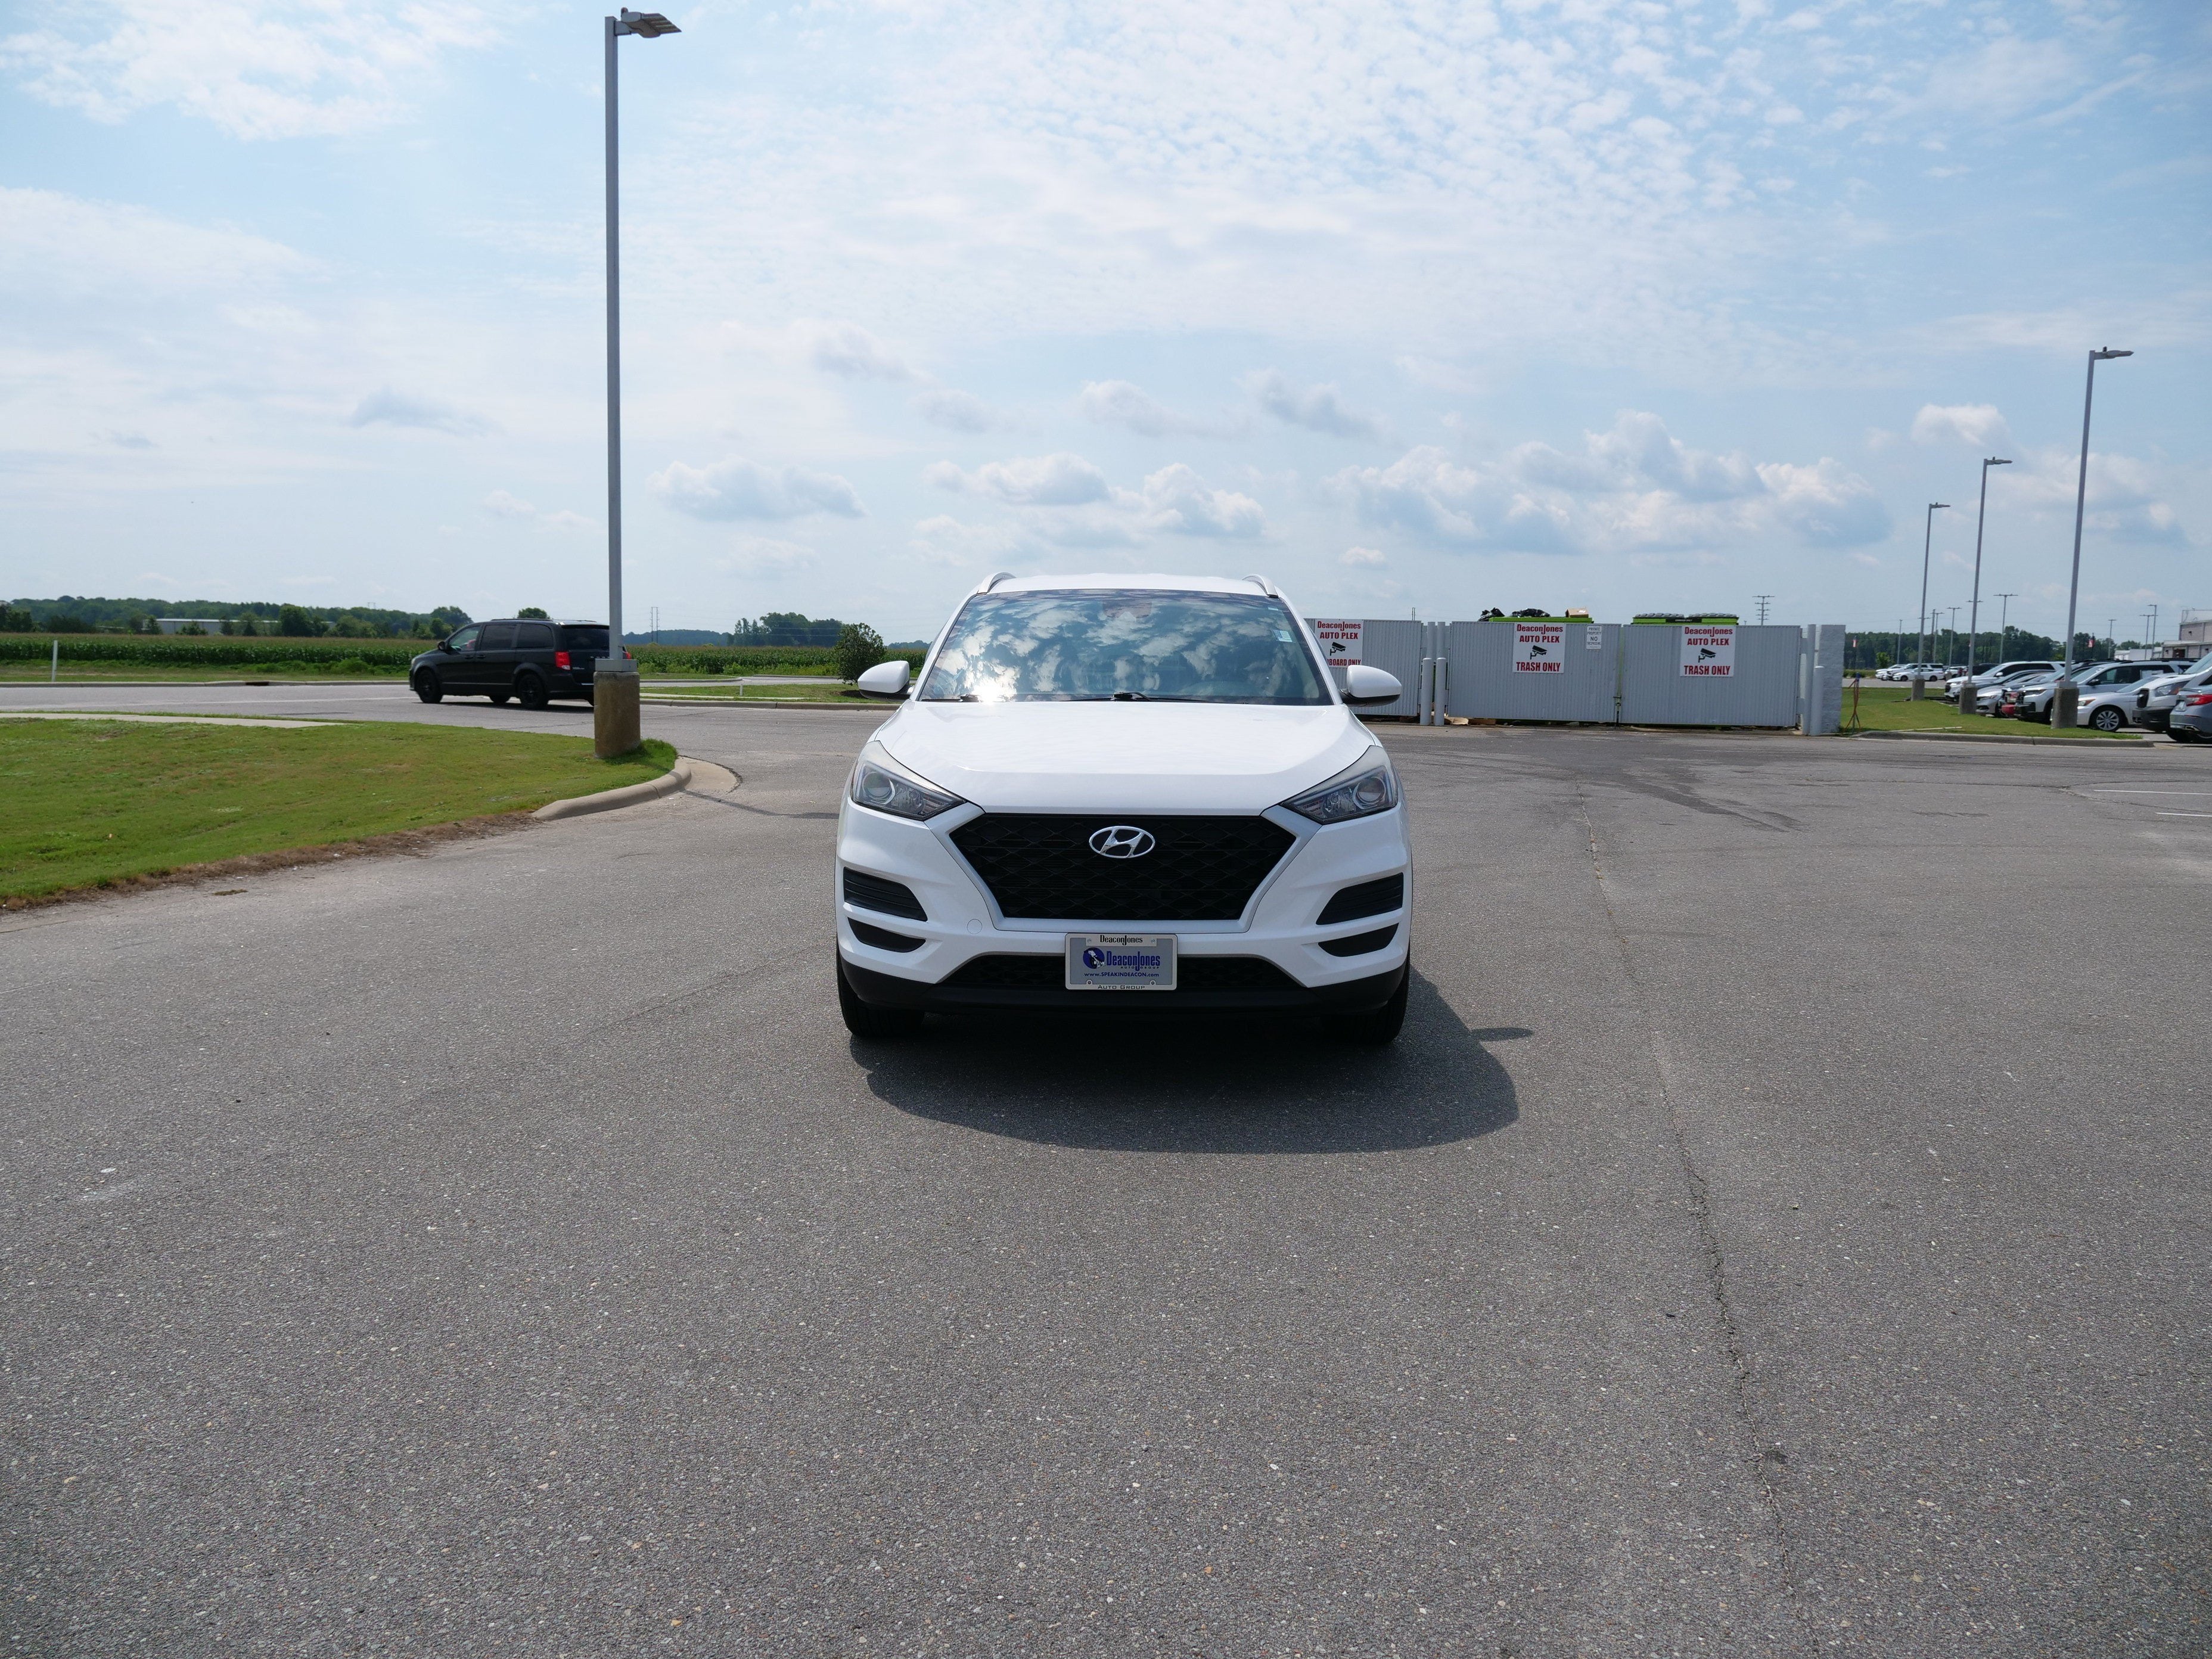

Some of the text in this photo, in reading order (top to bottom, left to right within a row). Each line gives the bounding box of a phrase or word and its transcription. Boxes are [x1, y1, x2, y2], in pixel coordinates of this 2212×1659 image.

[1318, 621, 1361, 631] DeaconJones
[1517, 624, 1563, 634] DeaconJones
[1685, 627, 1733, 637] DeaconJones
[1516, 662, 1561, 672] TRASH ONLY
[1684, 666, 1731, 675] TRASH ONLY
[1100, 934, 1143, 946] DeaconJones
[1106, 951, 1160, 971] DeaconJones
